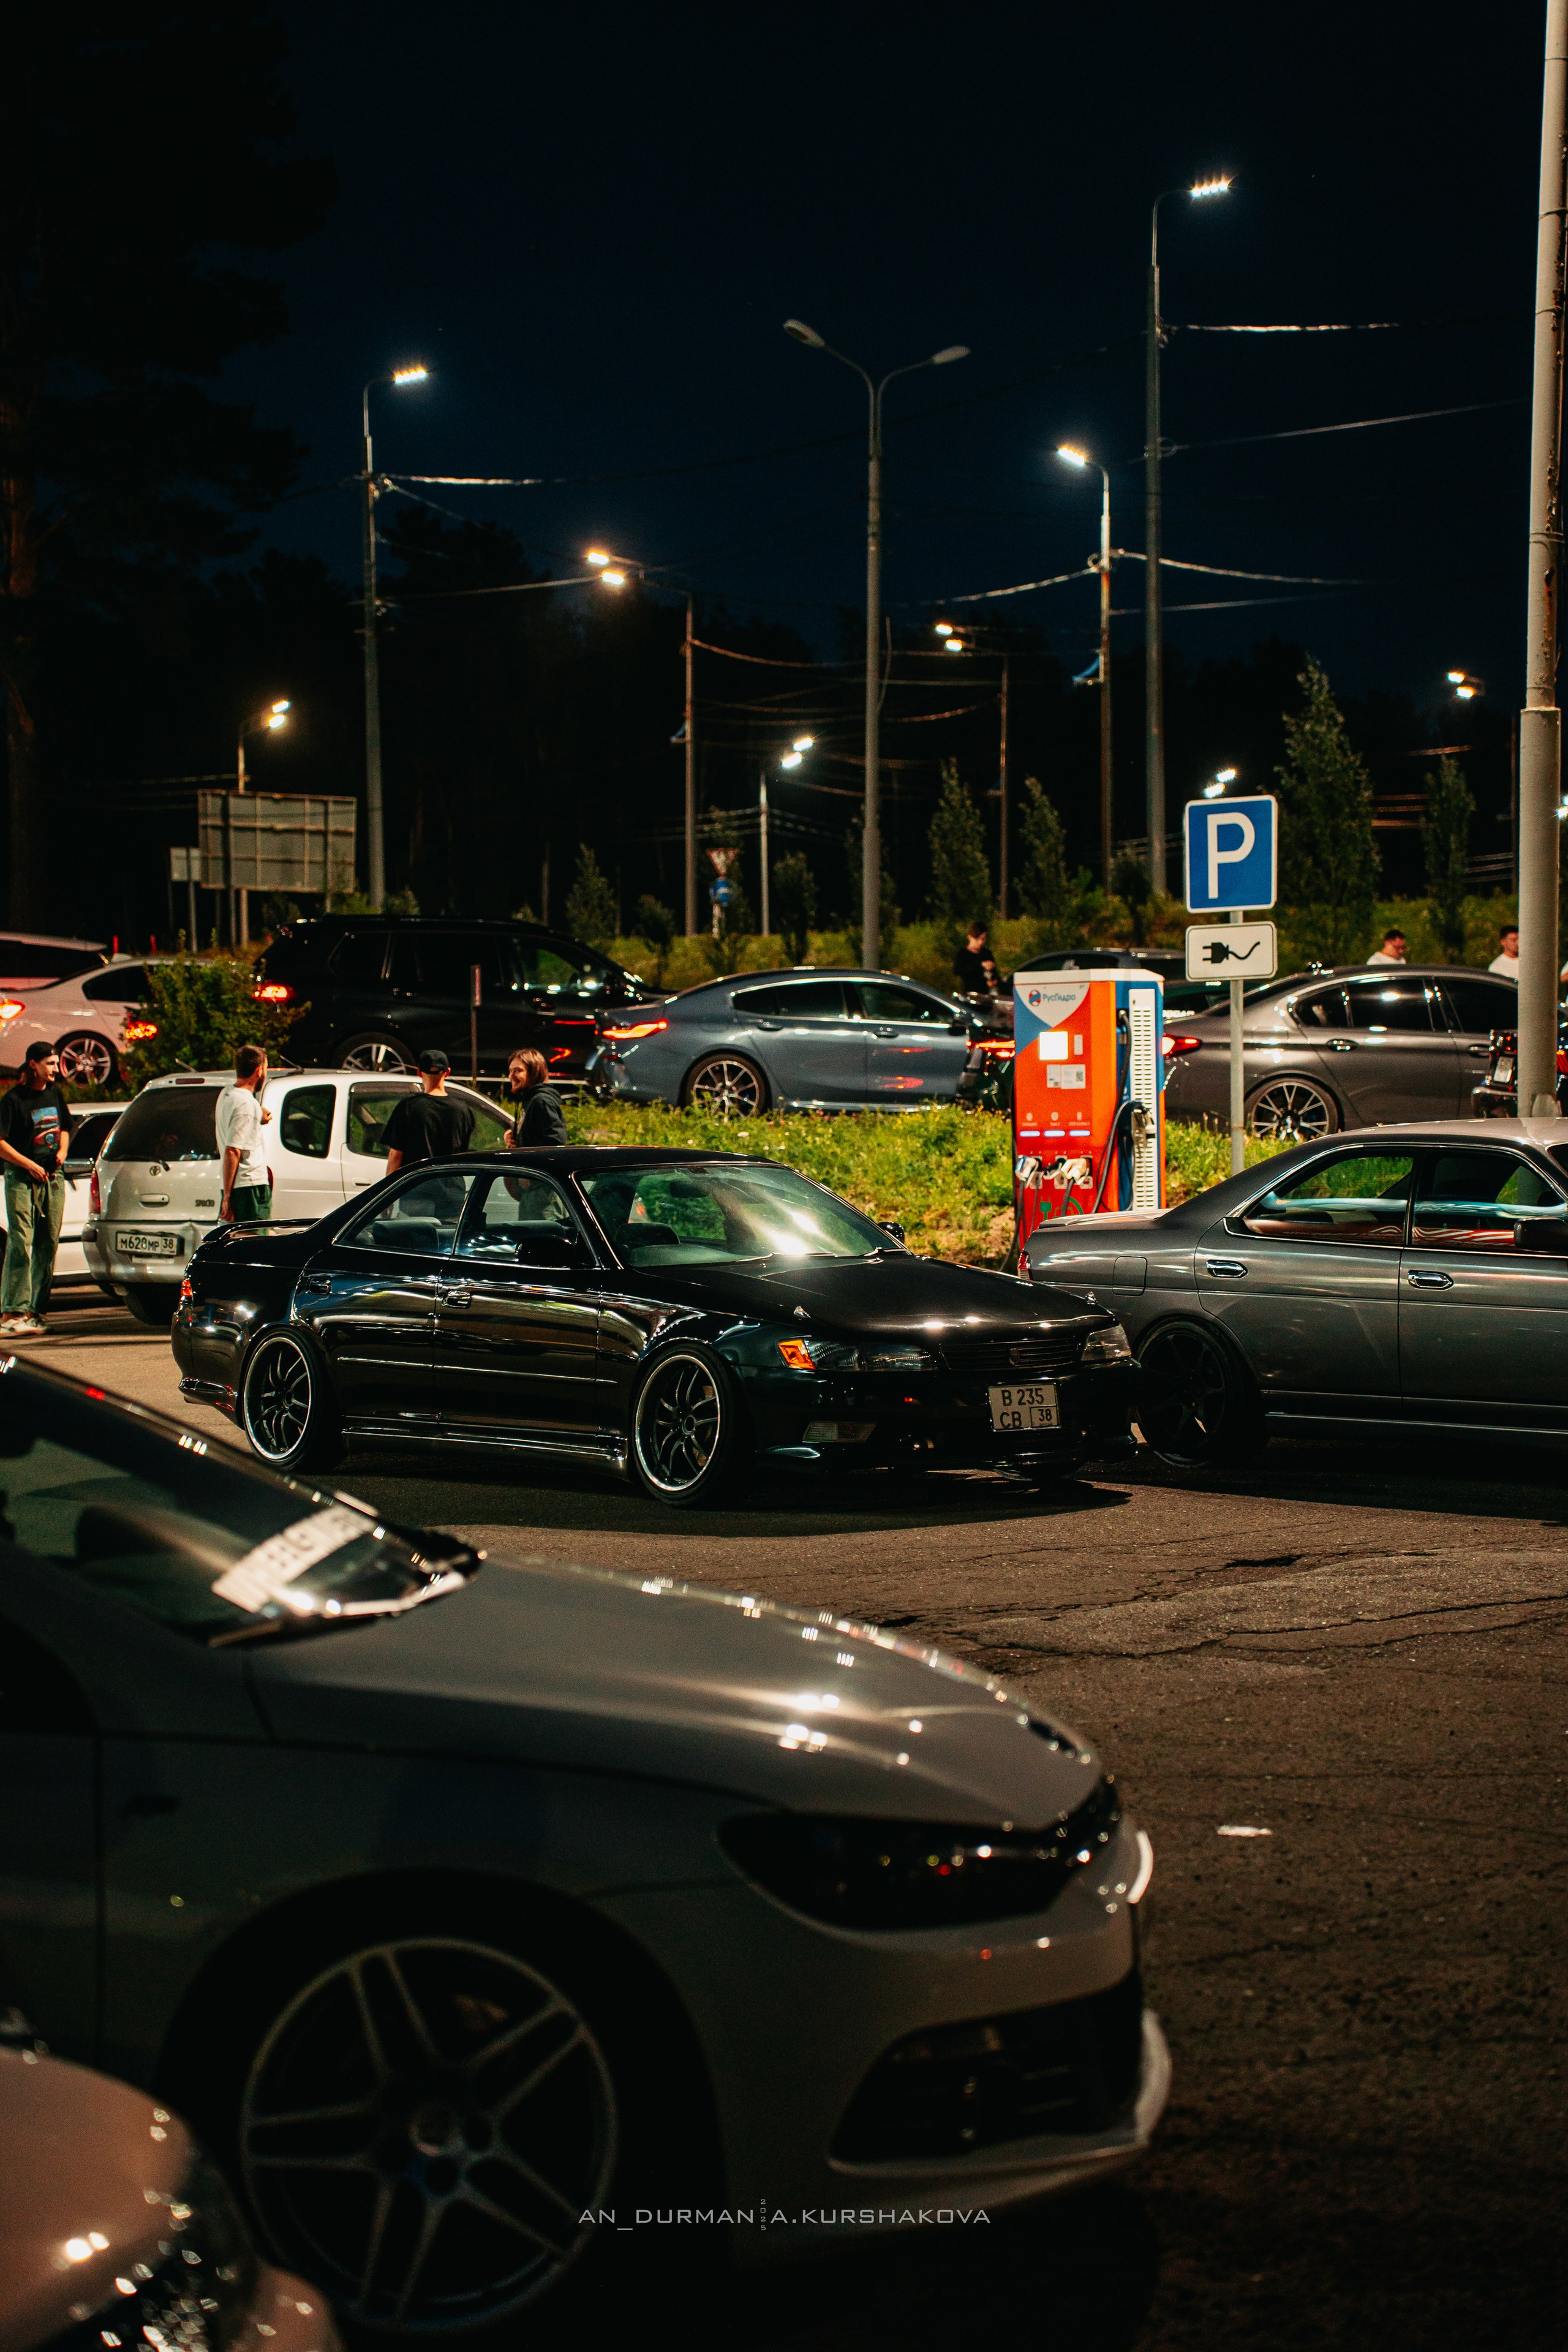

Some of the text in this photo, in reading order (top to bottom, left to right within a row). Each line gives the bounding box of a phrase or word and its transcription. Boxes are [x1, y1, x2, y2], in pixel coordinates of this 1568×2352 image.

[1207, 812, 1255, 899] P
[163, 1238, 173, 1249] 38
[1017, 1388, 1044, 1406] 235
[1038, 1409, 1052, 1422] 38
